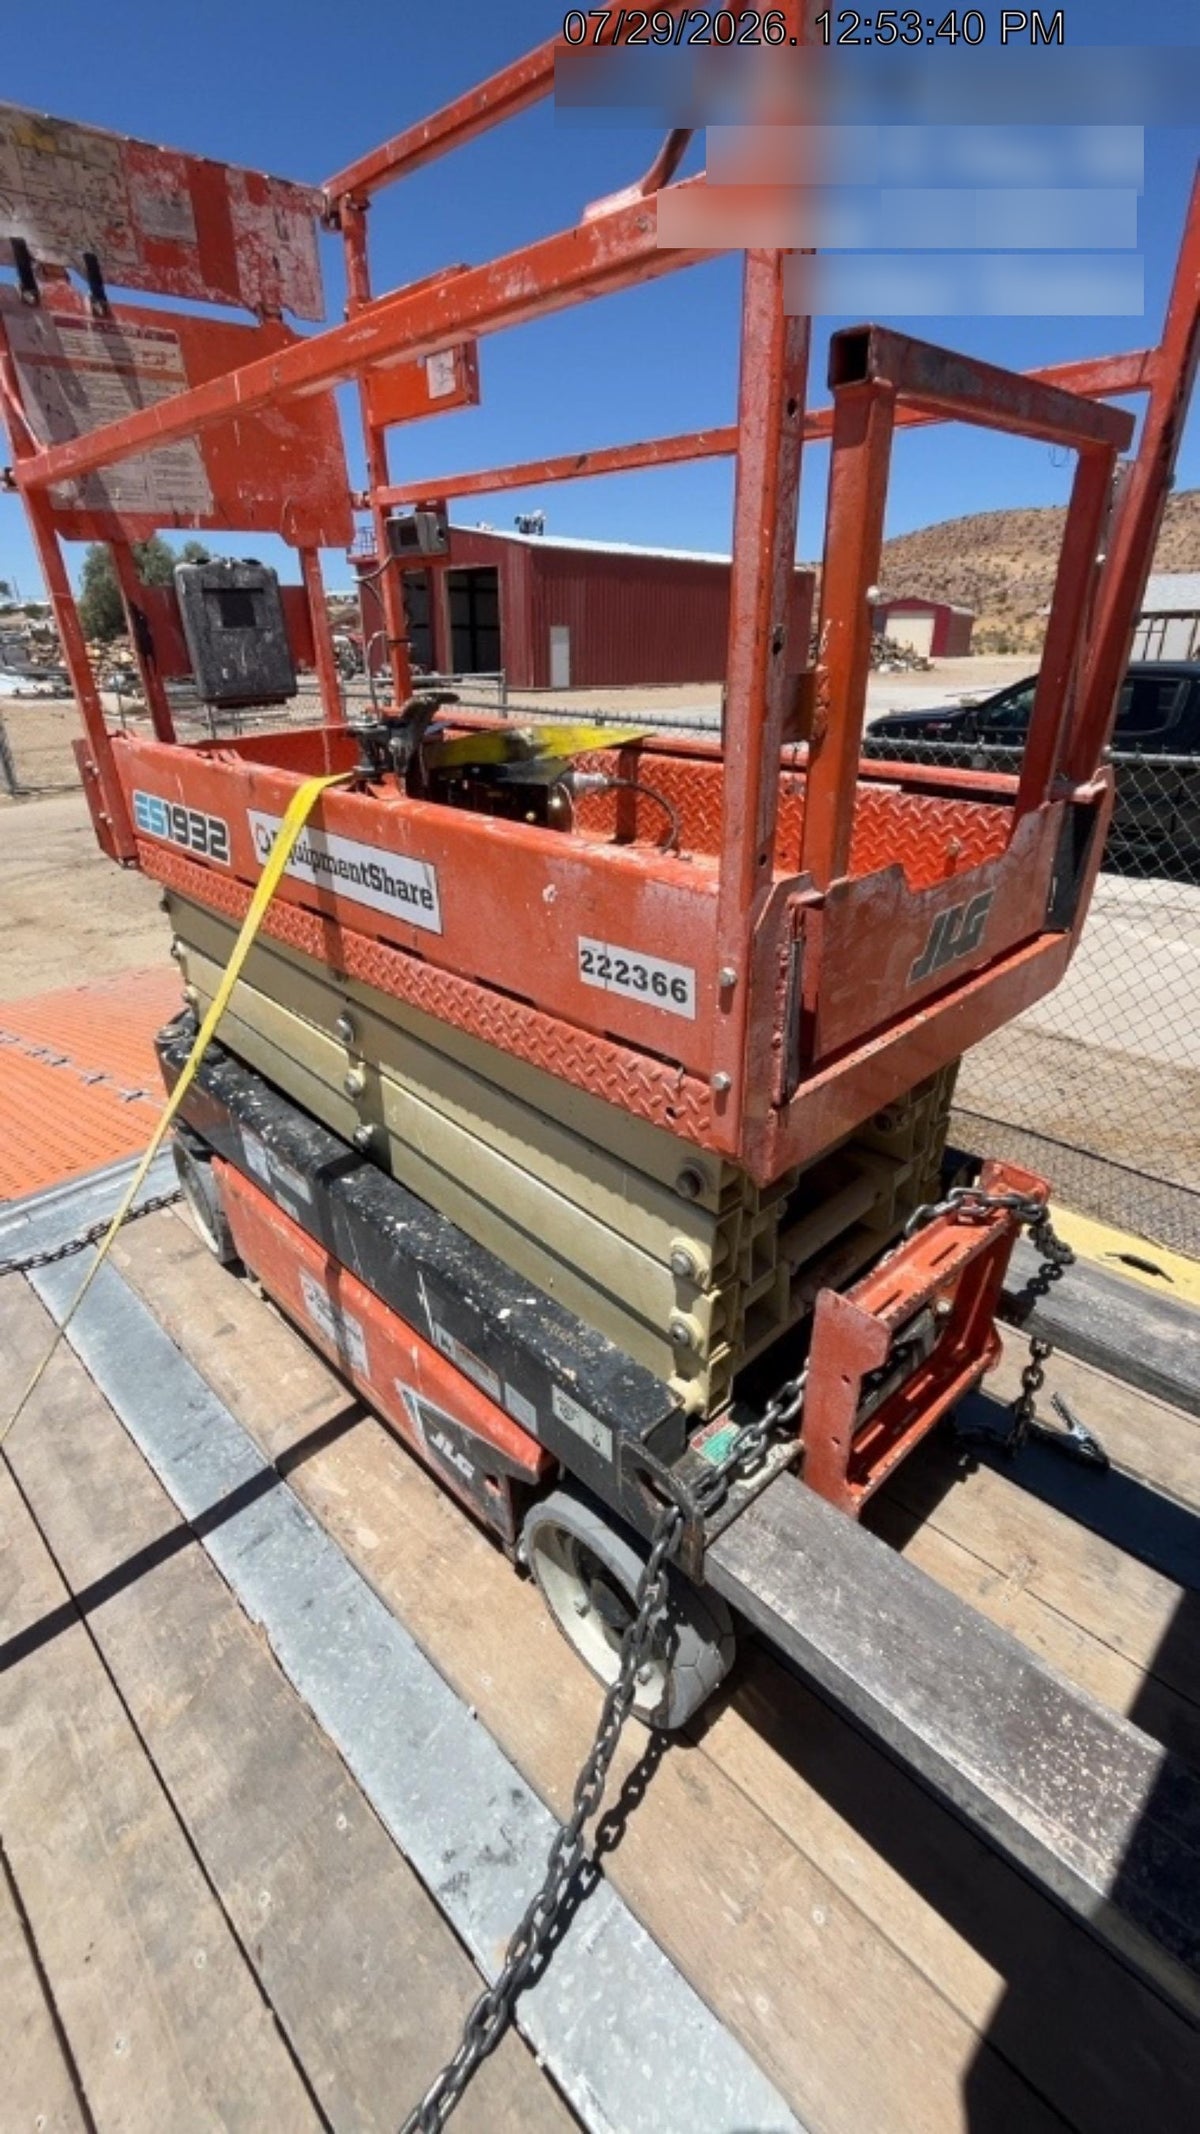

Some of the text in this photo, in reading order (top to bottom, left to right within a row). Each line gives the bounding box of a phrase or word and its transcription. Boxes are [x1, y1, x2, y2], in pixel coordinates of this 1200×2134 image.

[134, 792, 229, 861] ES1932
[908, 888, 995, 985] JLG
[579, 949, 689, 1004] 222366
